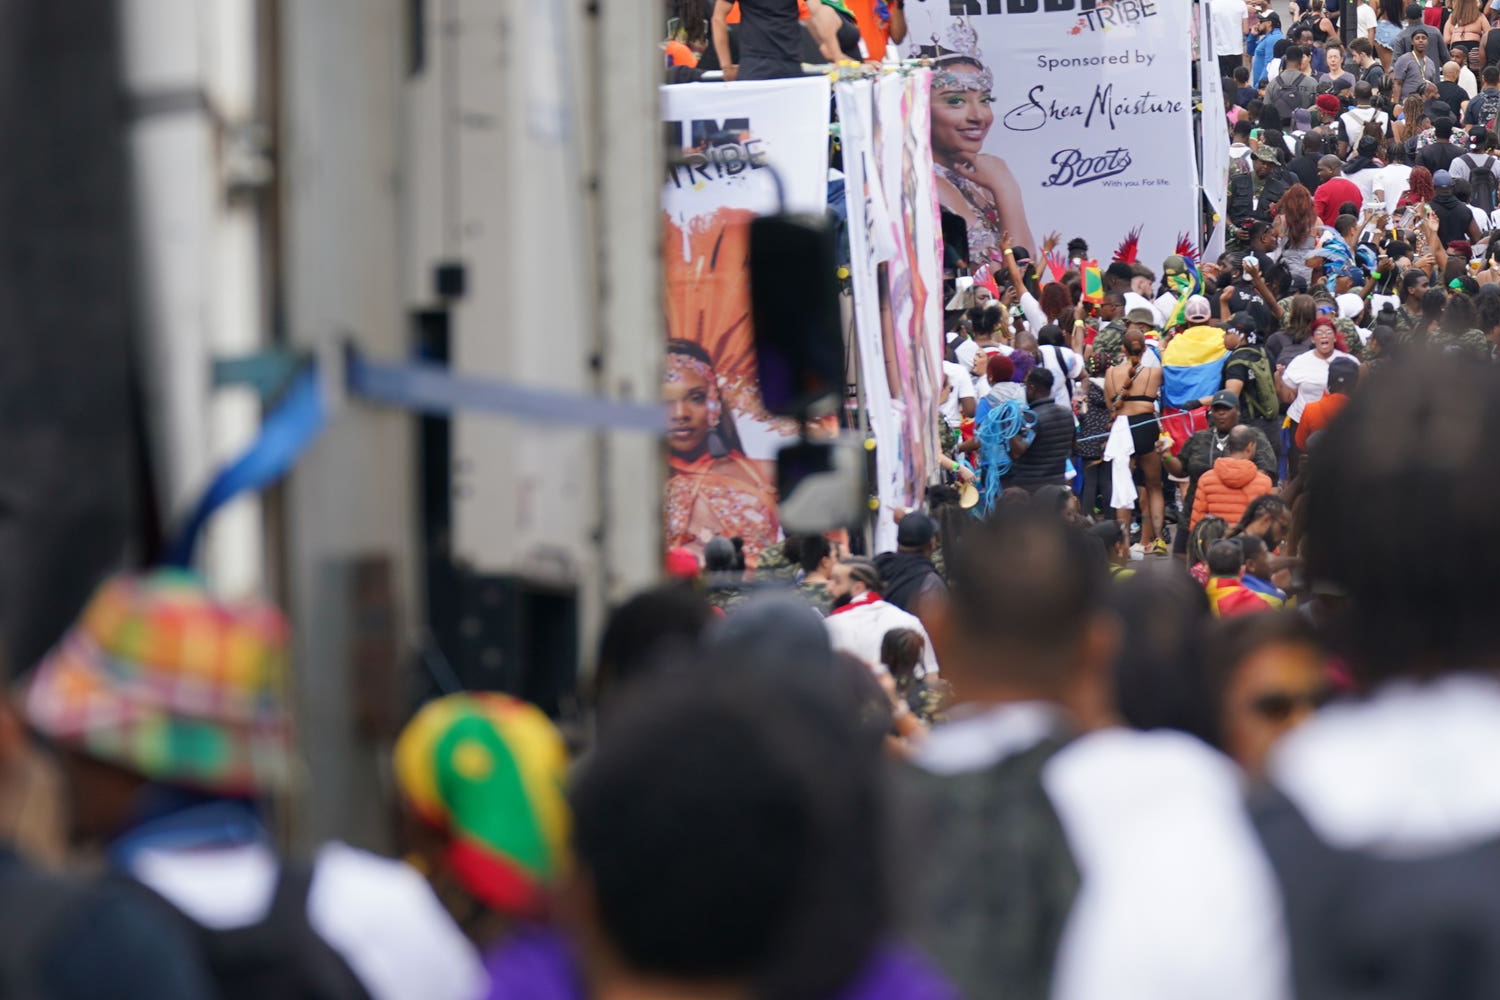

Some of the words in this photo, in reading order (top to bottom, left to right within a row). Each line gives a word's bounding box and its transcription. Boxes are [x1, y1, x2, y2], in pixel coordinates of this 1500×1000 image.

[1037, 50, 1129, 71] Sponsored
[1135, 49, 1156, 67] by
[1041, 147, 1132, 187] Boots
[1102, 179, 1123, 187] With
